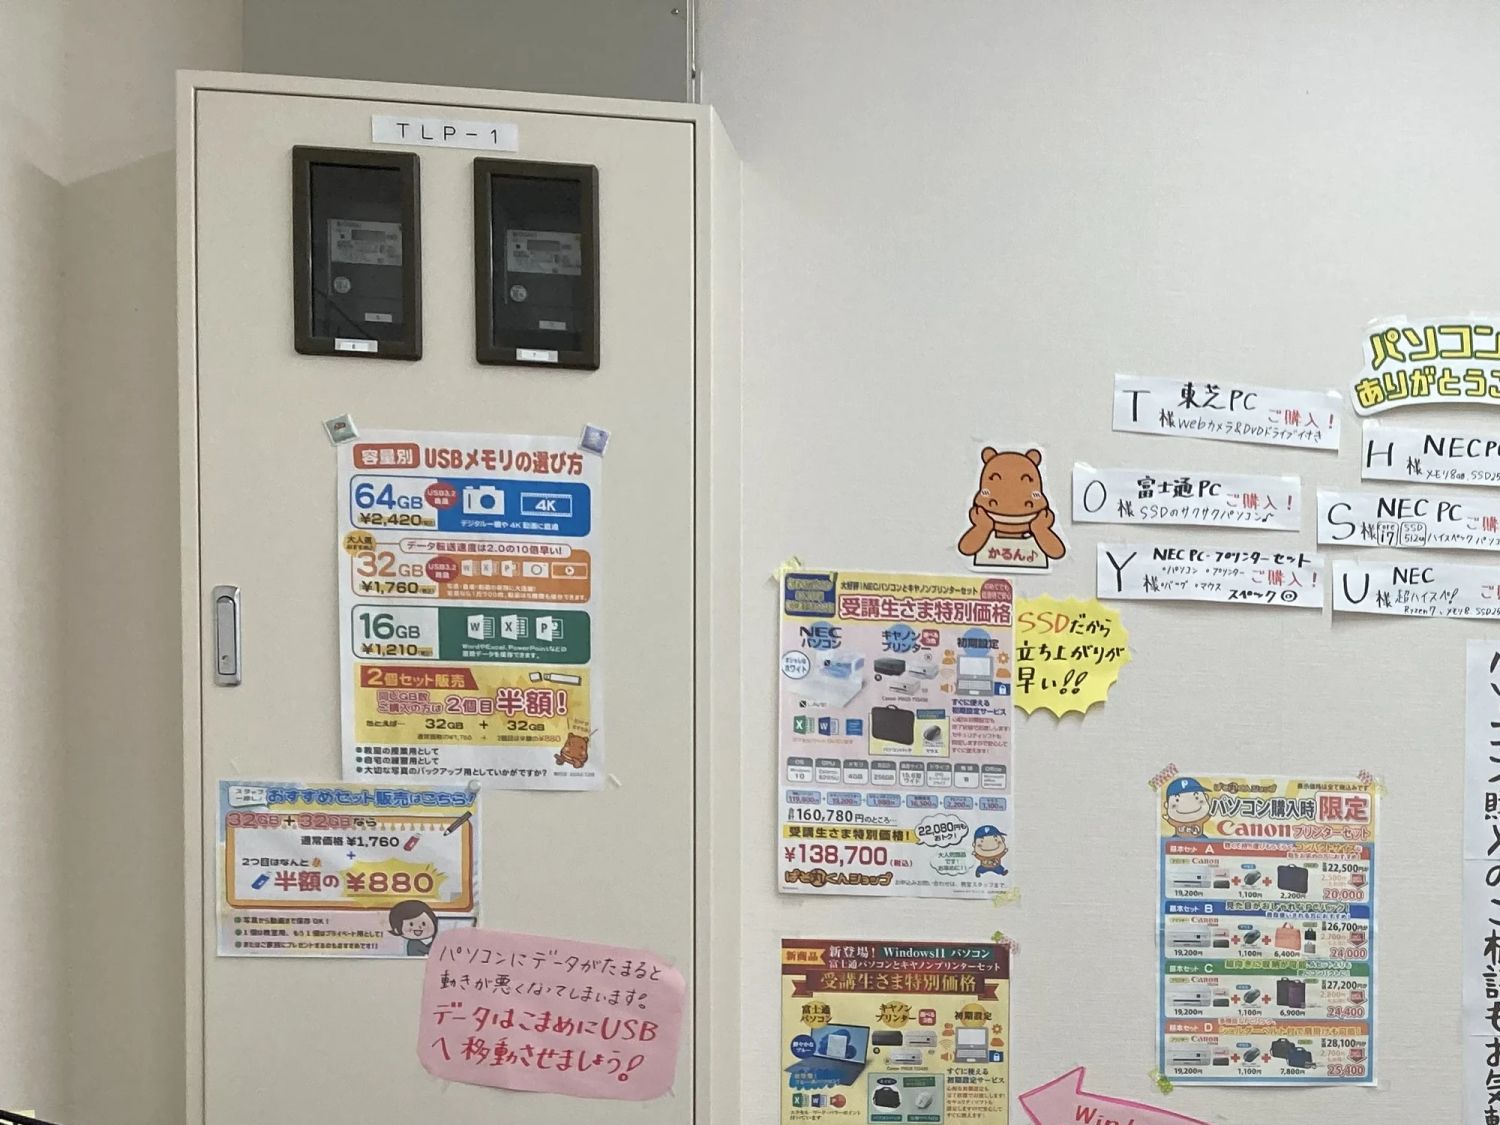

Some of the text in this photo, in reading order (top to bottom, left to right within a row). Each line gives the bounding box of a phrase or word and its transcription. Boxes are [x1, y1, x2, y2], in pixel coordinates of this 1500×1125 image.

[1123, 390, 1150, 422] T
[361, 448, 583, 476] 容量別 USBメモリの選び方
[1367, 440, 1393, 468] H
[355, 483, 556, 512] 64GB 4K
[1328, 497, 1463, 540] S NEC PC
[1106, 552, 1137, 592] Y
[1343, 567, 1434, 604] U NEC
[842, 599, 1011, 624] 受講生さま特別価格
[1018, 611, 1112, 635] SSDだから
[360, 612, 420, 639] 16GB
[802, 638, 842, 649] パソコン
[1017, 642, 1125, 664] 立ち上がりが
[367, 668, 465, 688] 2個セット販売
[1211, 796, 1369, 821] パソコン購入時 限定
[1217, 821, 1370, 839] Canon プリンターセット
[785, 844, 888, 866] ¥138,700
[440, 946, 662, 981] パソコンにデータがたまると
[884, 947, 945, 959] Windows11
[440, 970, 648, 1010] 動きが悪くなってしまいます!
[820, 973, 976, 991] 受講生さま特別価格
[433, 1002, 658, 1041] データはこまめにUSB
[431, 1036, 644, 1082] へ移動させましょう!
